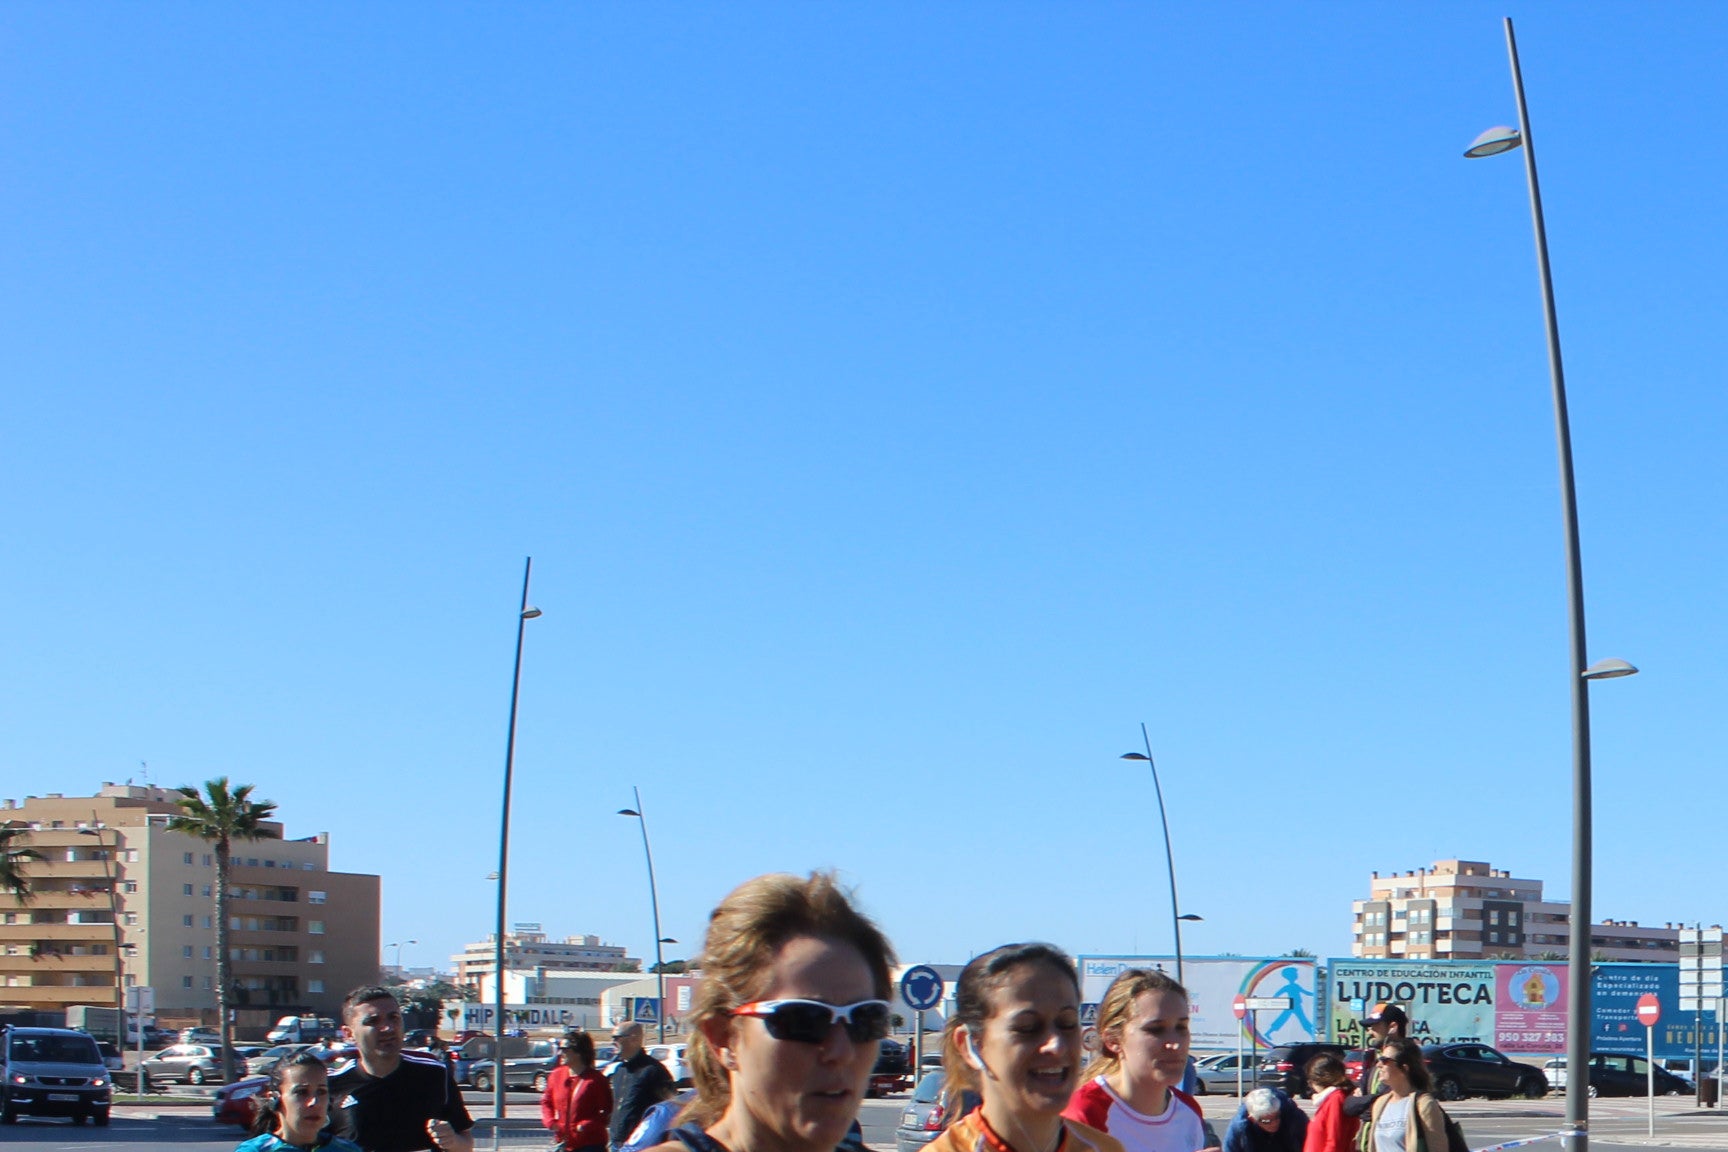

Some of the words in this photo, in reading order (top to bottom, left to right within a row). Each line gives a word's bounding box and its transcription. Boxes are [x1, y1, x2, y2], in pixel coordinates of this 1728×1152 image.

[1086, 962, 1117, 975] Helen
[1336, 968, 1375, 977] CENTRO
[1376, 969, 1389, 978] DE
[1449, 970, 1493, 980] INFANTIL
[1596, 981, 1661, 990] Especializado
[1336, 980, 1493, 1005] LUDOTECA
[1336, 1018, 1359, 1033] LA
[1498, 1032, 1520, 1042] 950
